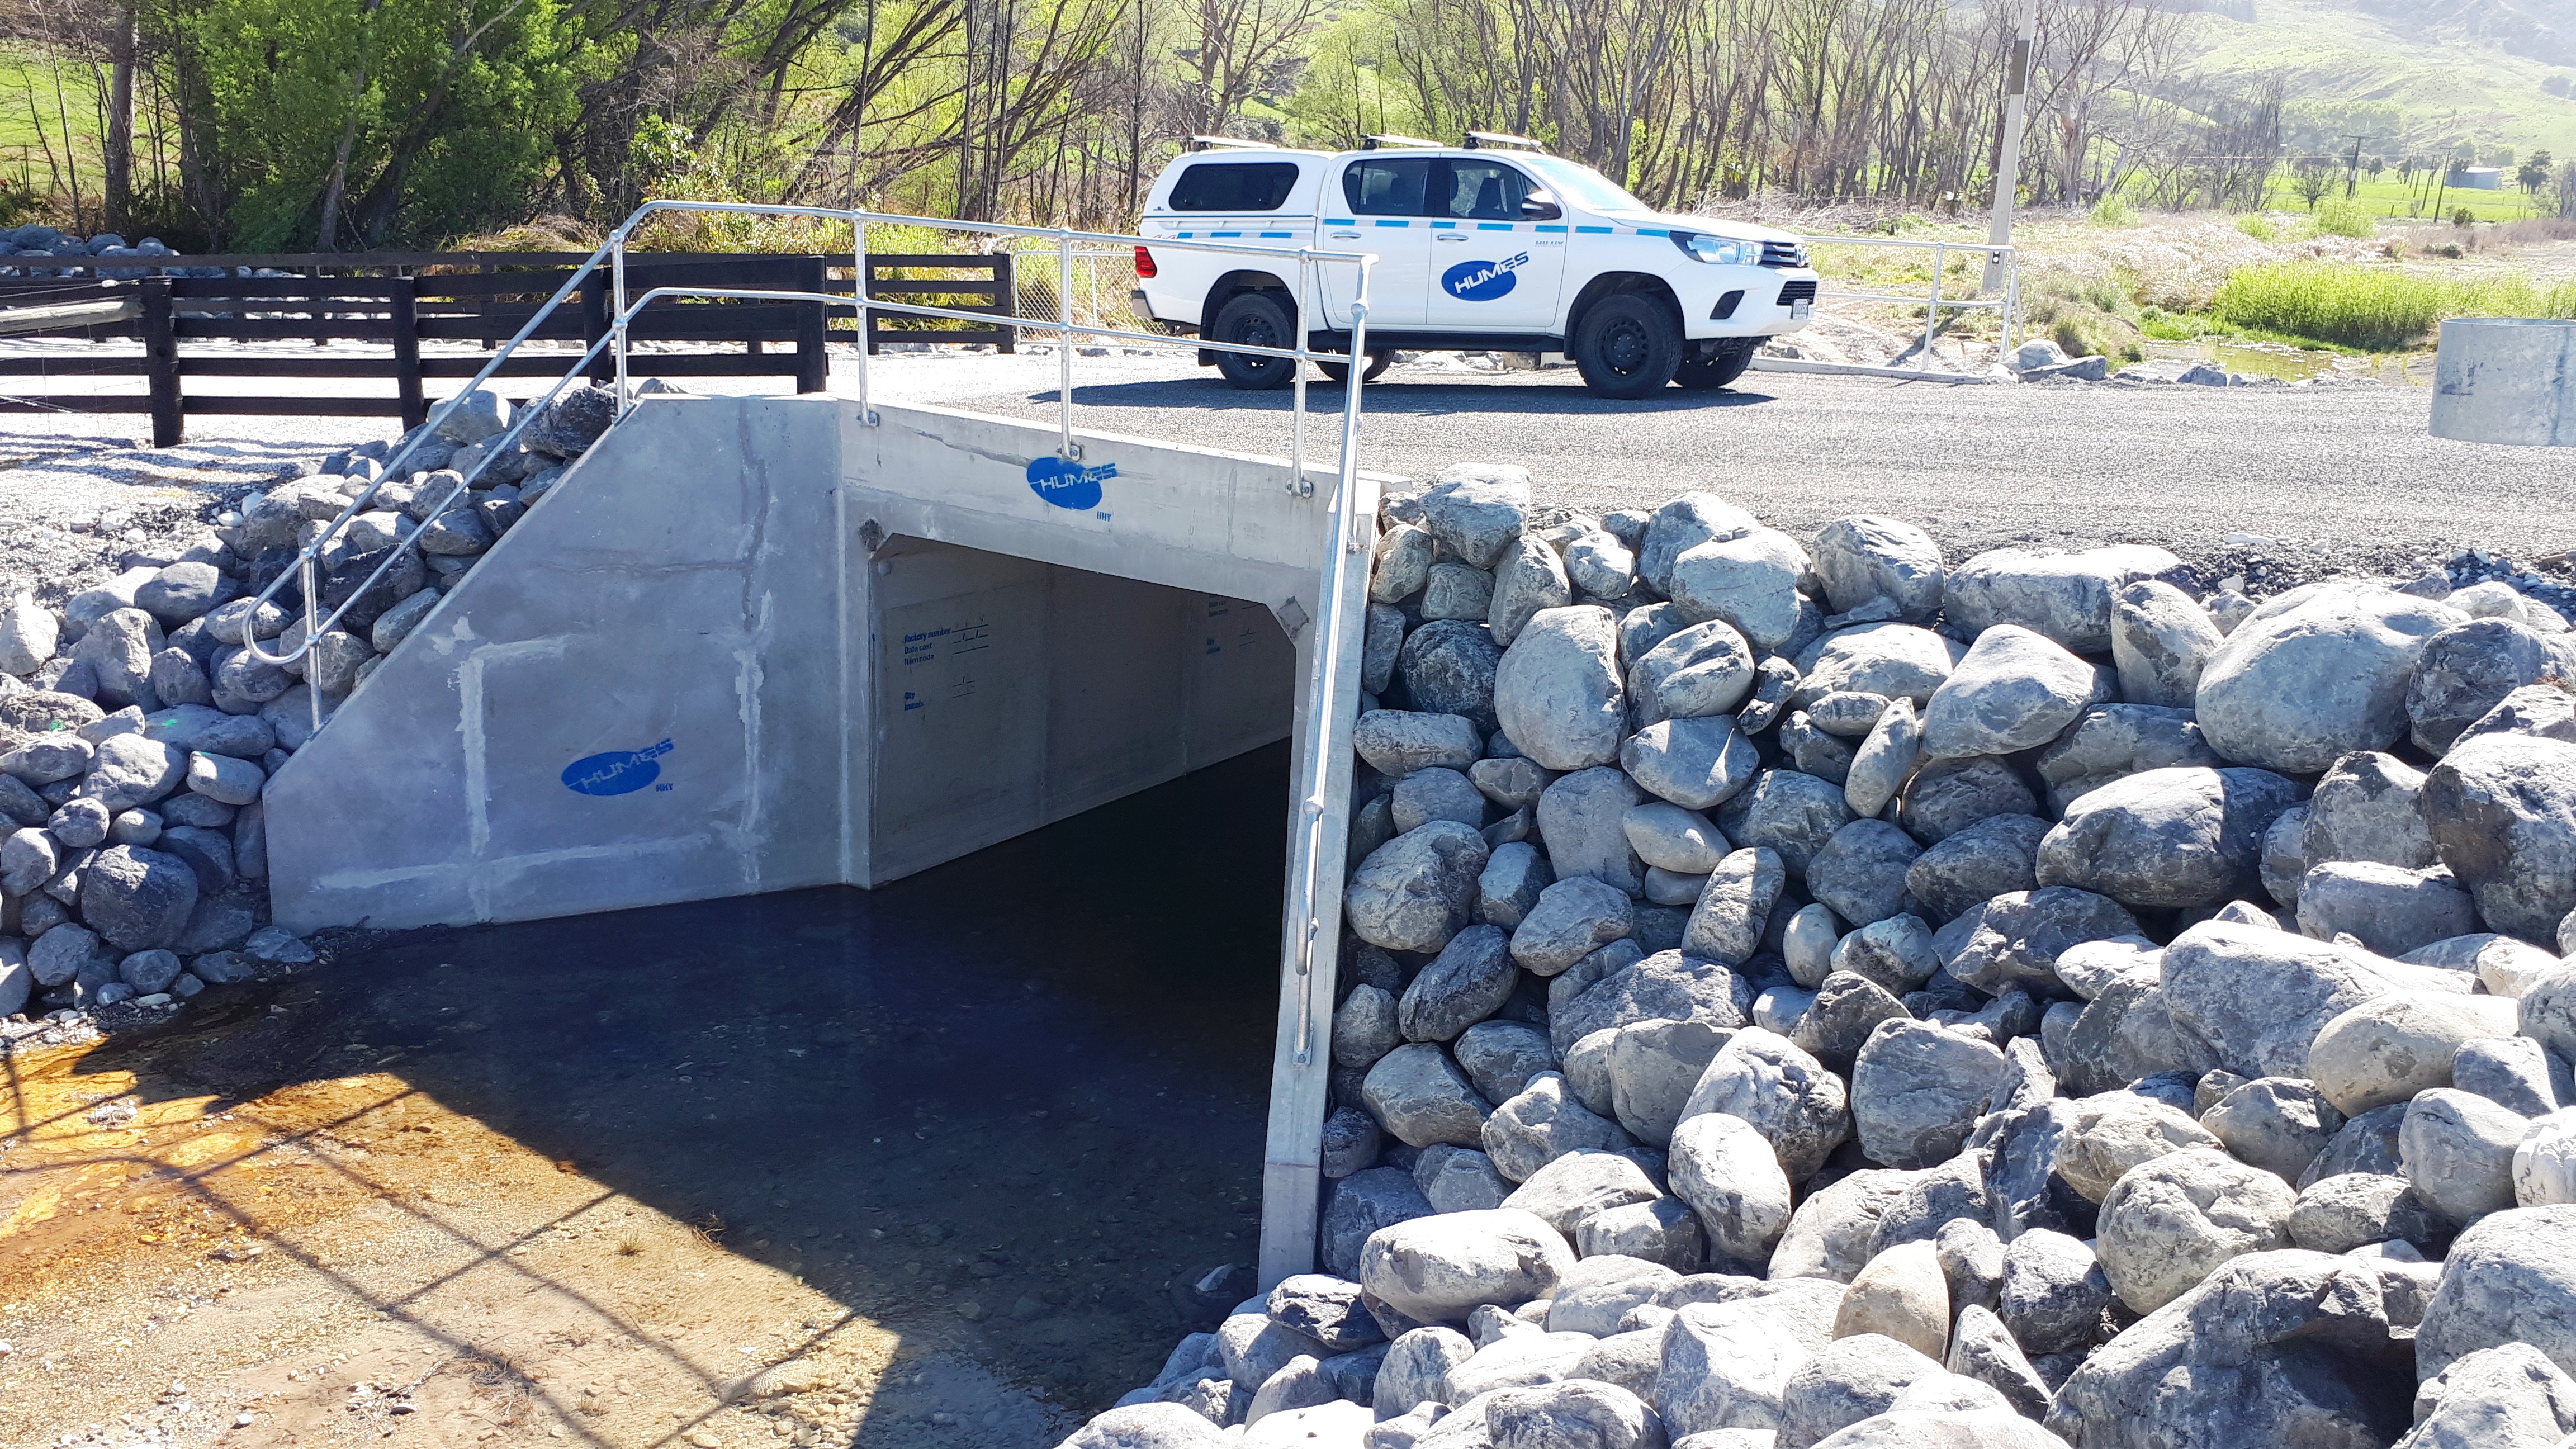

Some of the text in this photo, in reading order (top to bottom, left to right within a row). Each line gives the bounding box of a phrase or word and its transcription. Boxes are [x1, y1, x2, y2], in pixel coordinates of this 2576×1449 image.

[1455, 250, 1529, 294] HUMES
[1040, 462, 1117, 491] HUMES
[928, 628, 951, 638] number
[919, 654, 934, 662] code
[581, 738, 674, 789] HUMES
